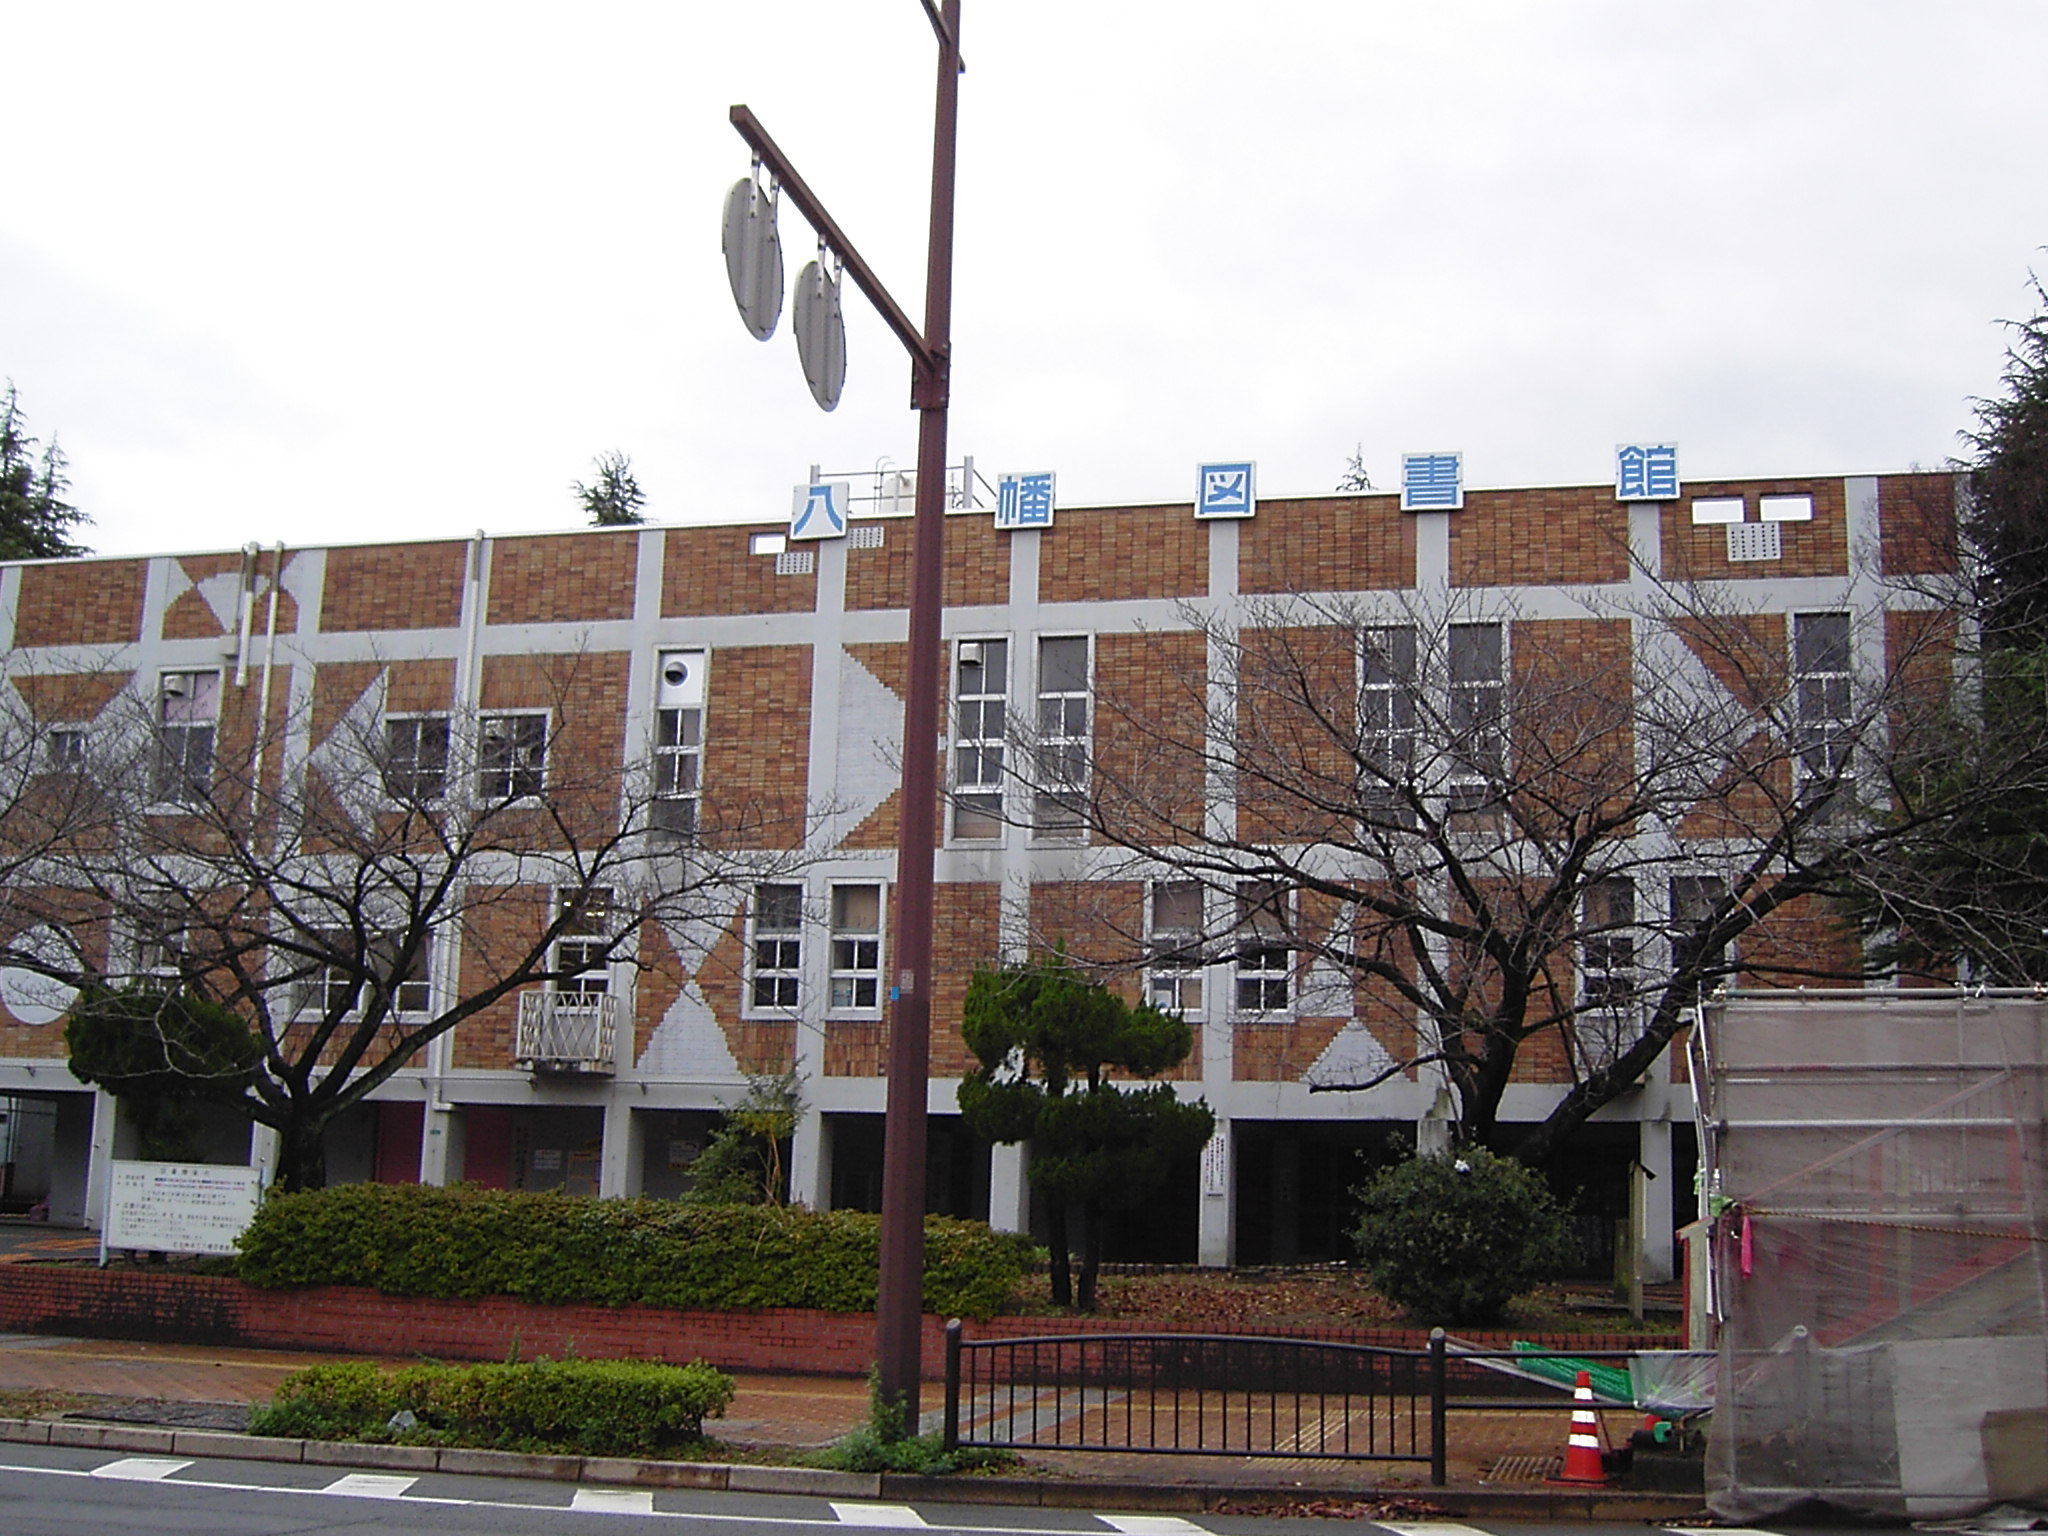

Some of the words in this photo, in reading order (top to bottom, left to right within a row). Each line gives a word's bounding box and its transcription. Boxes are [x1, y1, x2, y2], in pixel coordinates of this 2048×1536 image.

[795, 446, 1676, 533] 八幡図書館
